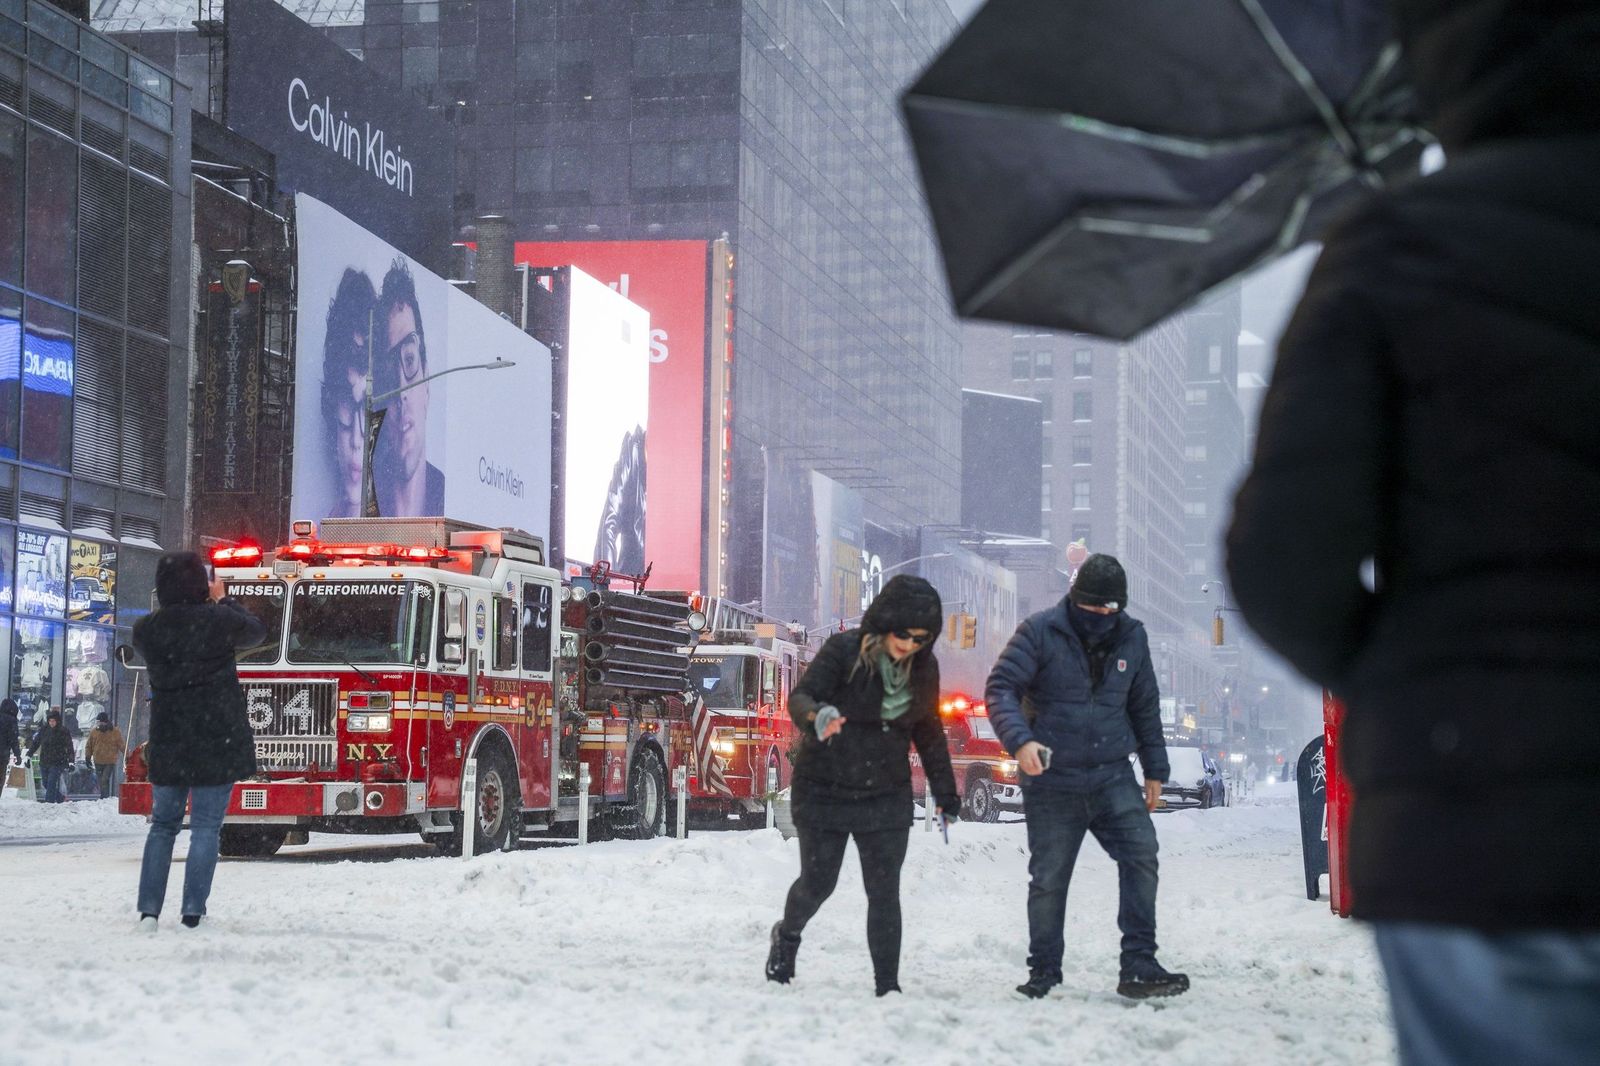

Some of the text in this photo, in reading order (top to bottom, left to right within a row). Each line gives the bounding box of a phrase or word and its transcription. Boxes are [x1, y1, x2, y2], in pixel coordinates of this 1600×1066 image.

[288, 77, 414, 197] Calvin Klein
[223, 307, 241, 489] PLAYWRIGHT TAVERN
[478, 455, 524, 500] Calvin Klein
[228, 585, 406, 596] MISSED A PERFORMANCE
[246, 688, 312, 731] 54
[525, 691, 546, 727] 54
[346, 743, 397, 761] N.Y.
